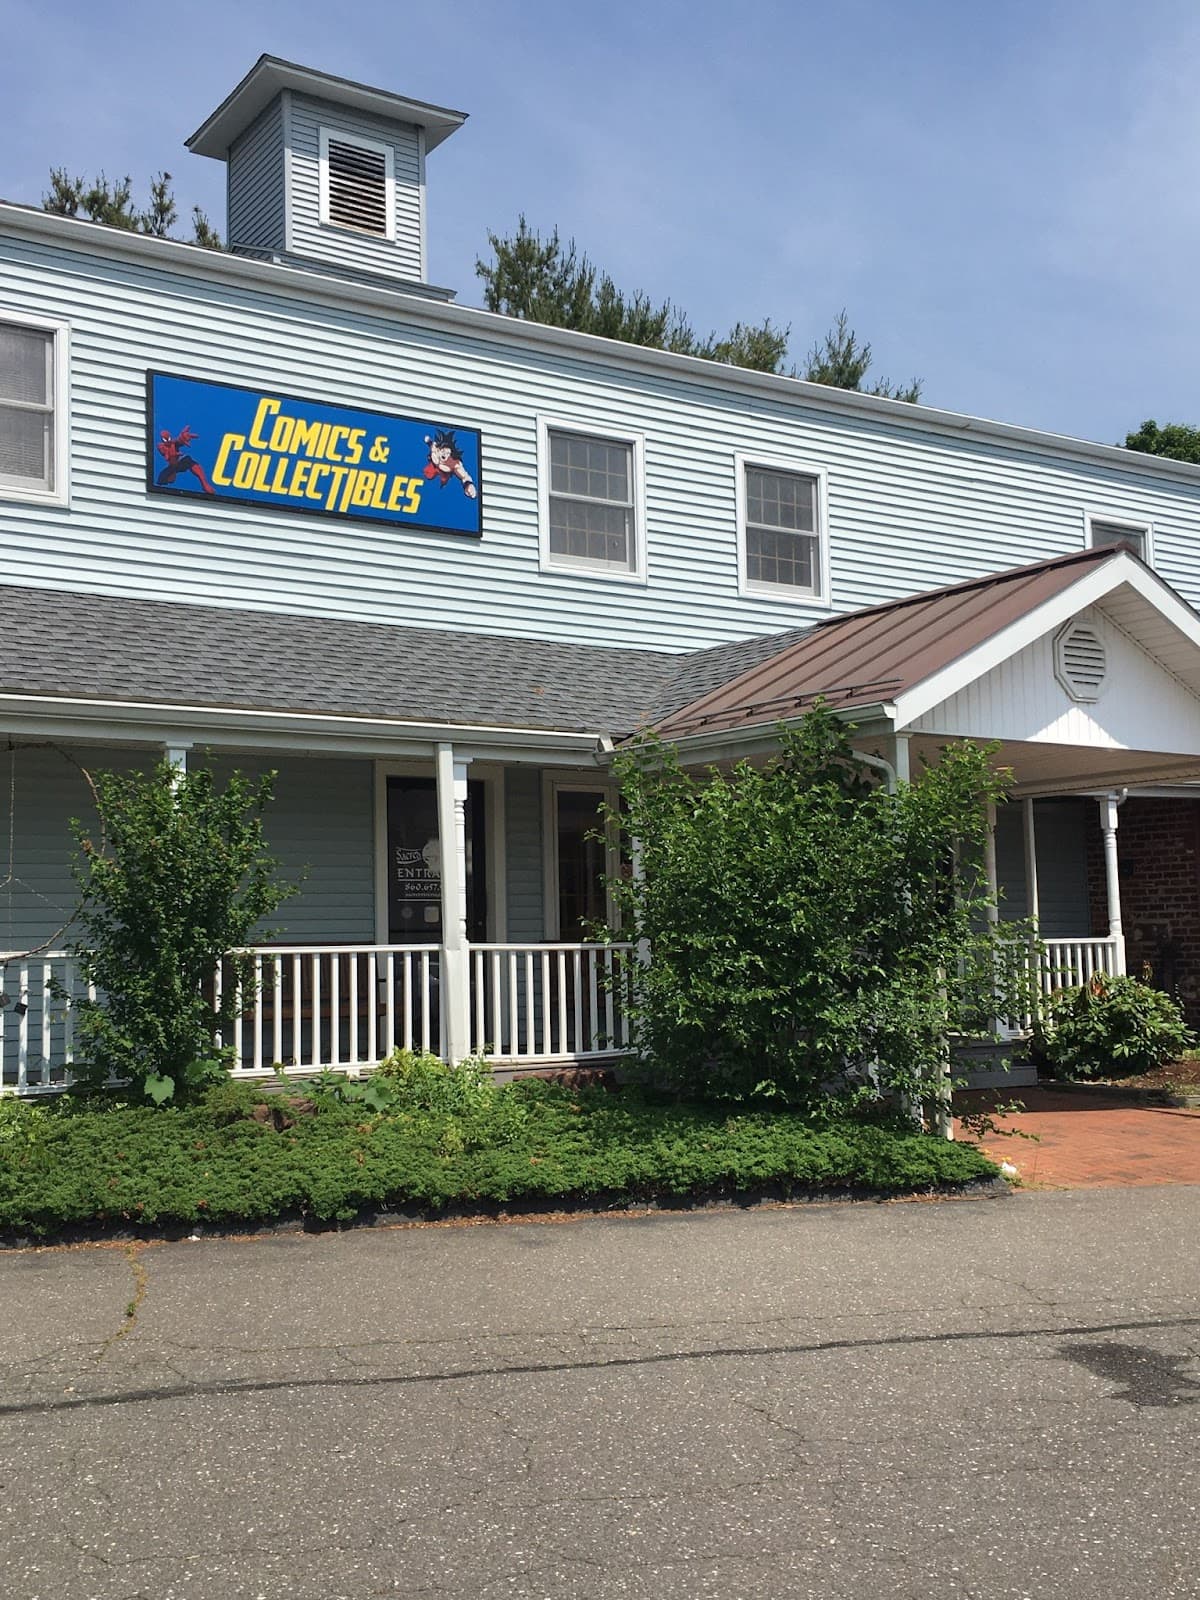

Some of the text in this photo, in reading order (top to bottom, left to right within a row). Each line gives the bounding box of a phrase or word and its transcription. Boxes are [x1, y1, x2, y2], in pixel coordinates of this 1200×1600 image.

[249, 398, 390, 465] COMICS &
[211, 433, 424, 514] COLLECTIBLES
[397, 868, 440, 878] ENTRA
